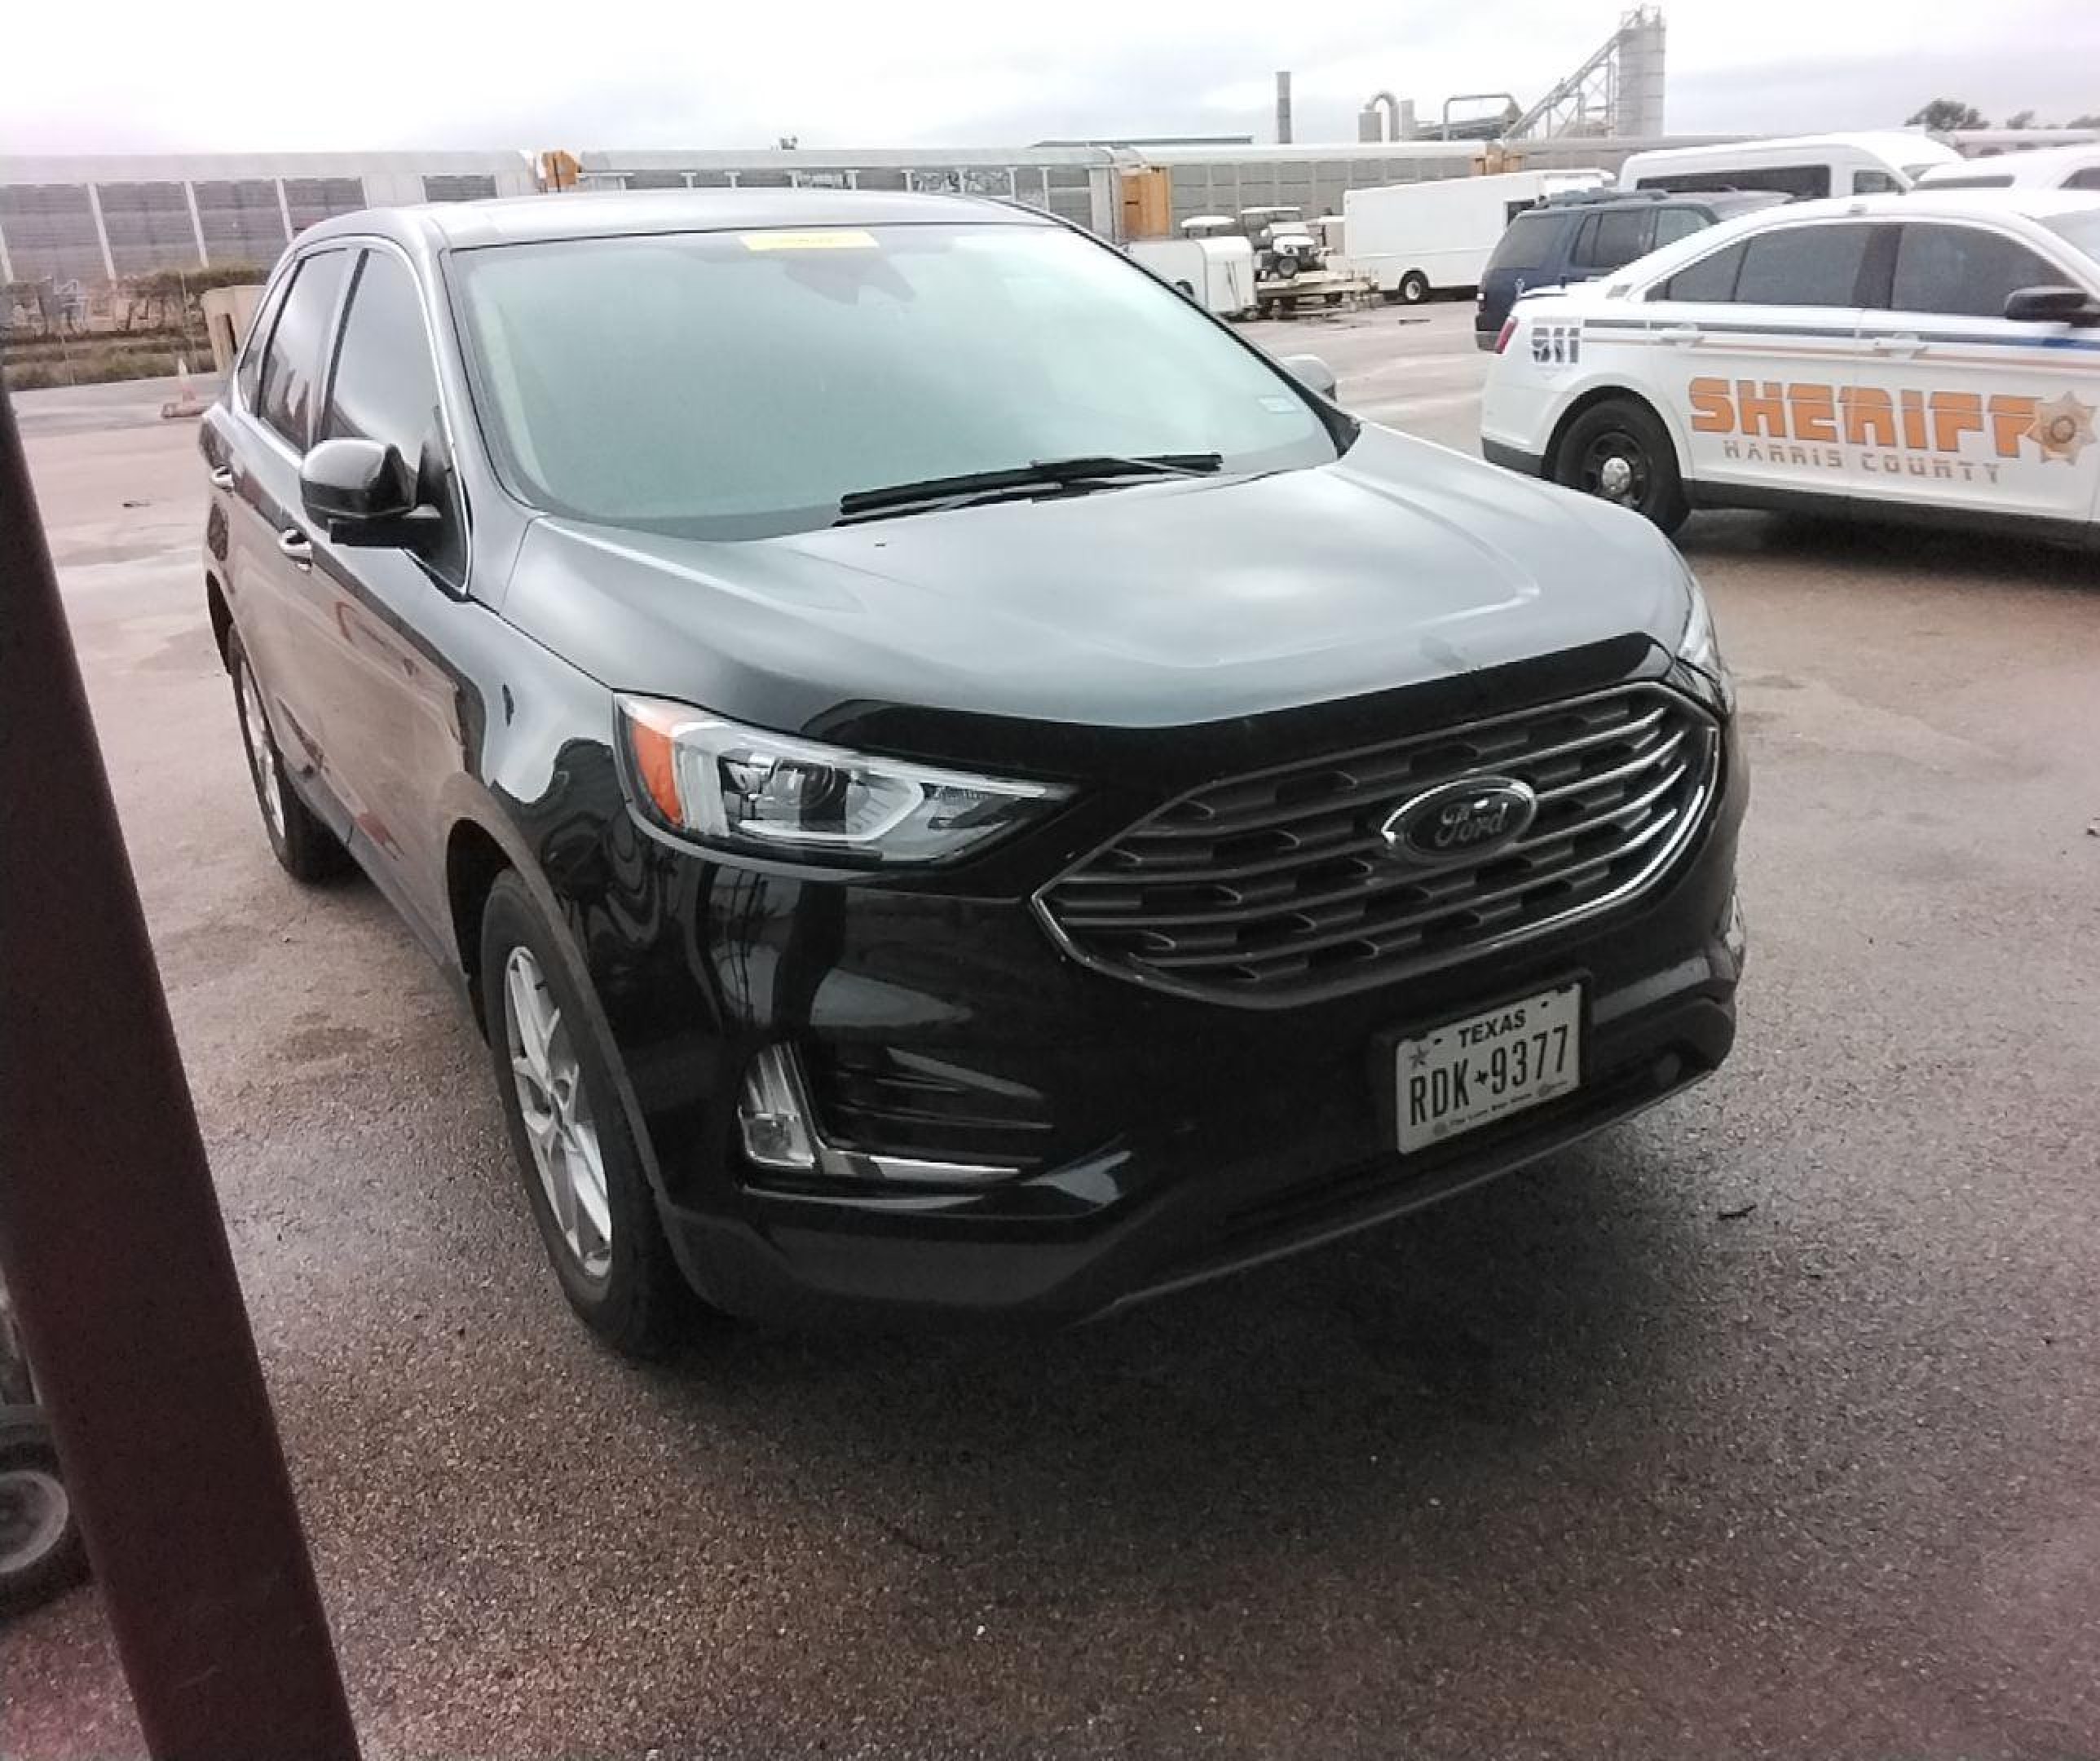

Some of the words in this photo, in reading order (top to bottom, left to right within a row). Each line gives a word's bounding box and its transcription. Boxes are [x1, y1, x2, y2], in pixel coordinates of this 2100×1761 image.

[1688, 377, 2043, 459] SHERIFF
[1723, 439, 1842, 467] HARRIS
[1861, 453, 1999, 483] COUNTY
[1435, 801, 1508, 847] Ford
[1458, 1009, 1526, 1048] TEXAS
